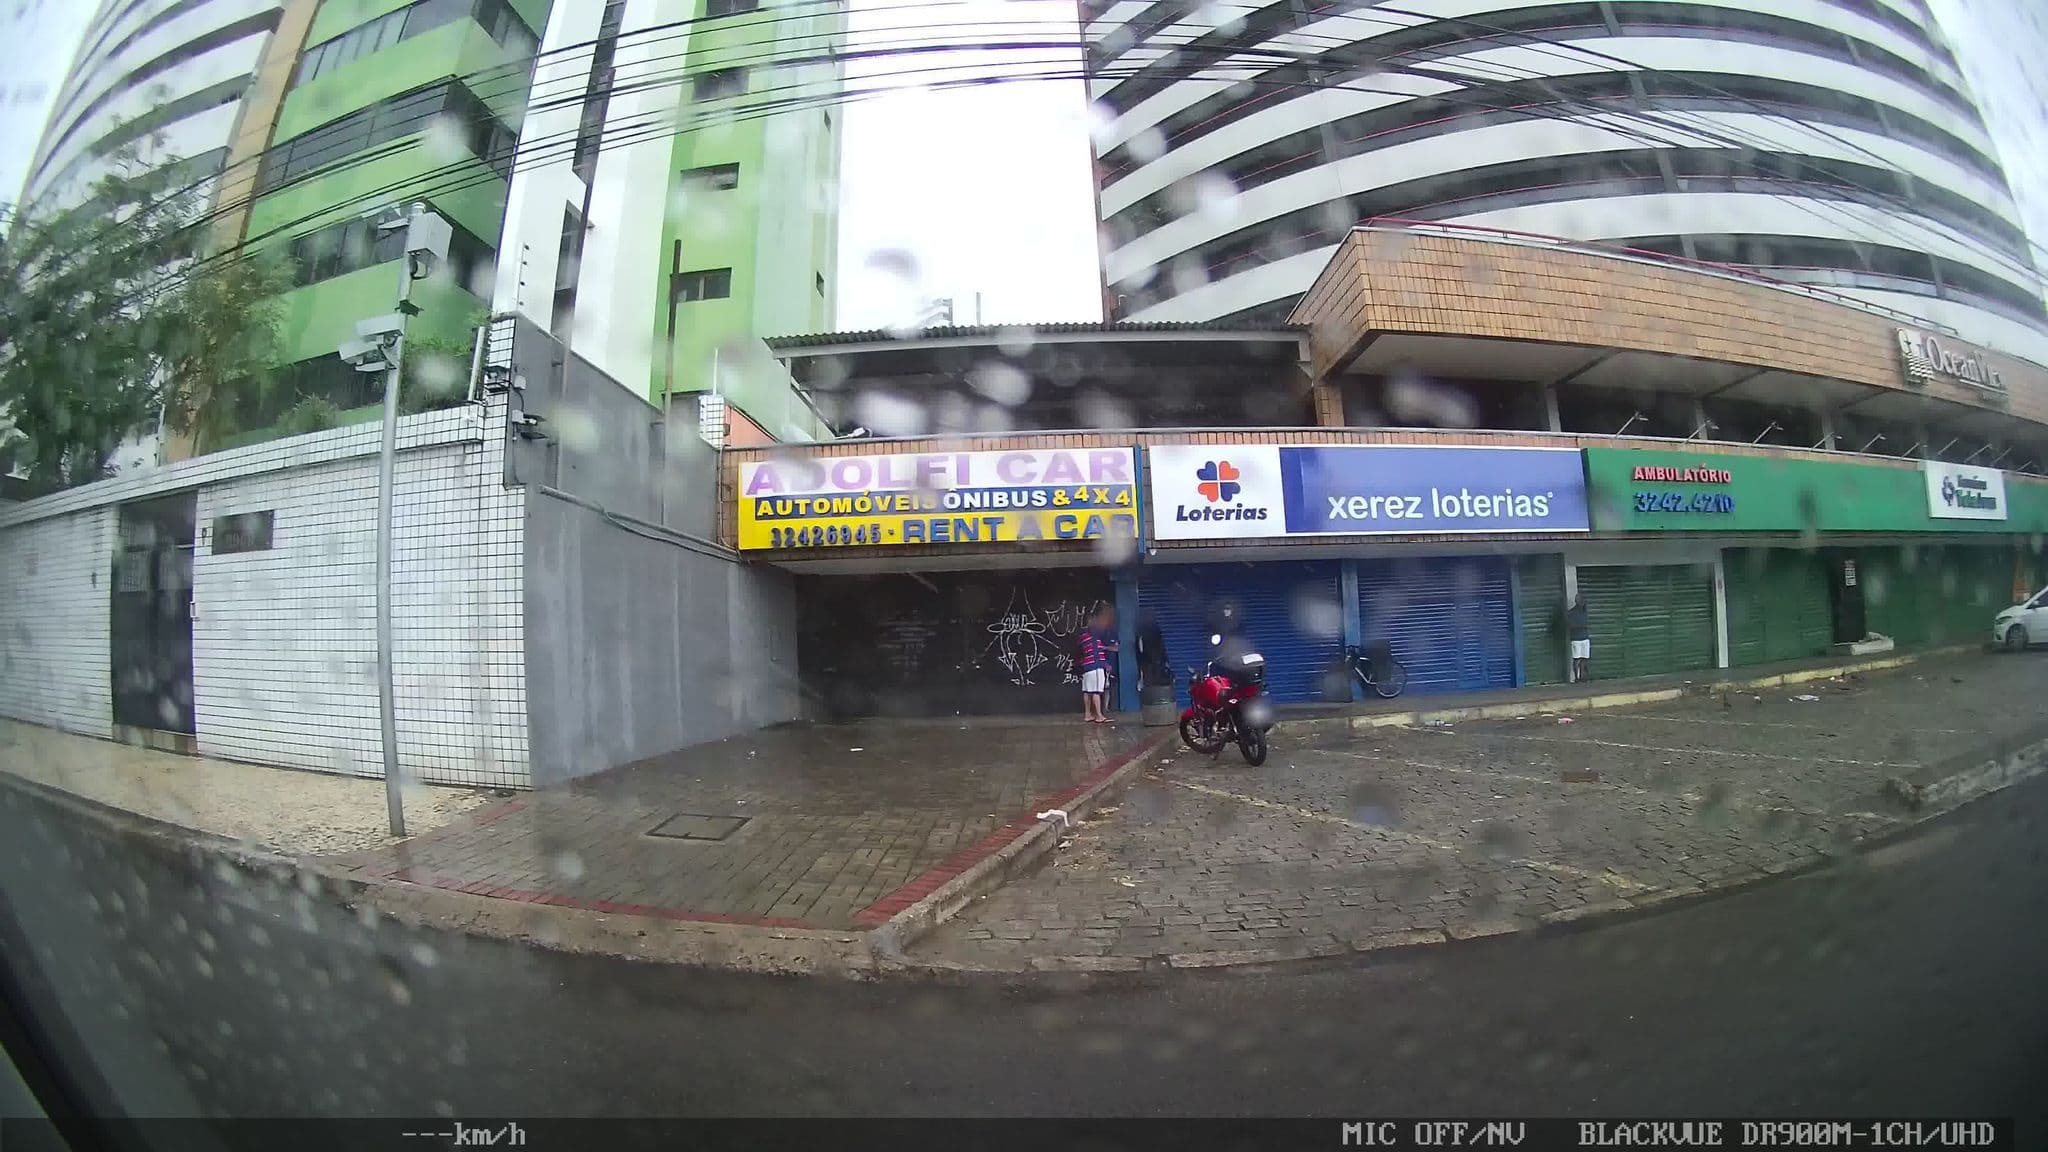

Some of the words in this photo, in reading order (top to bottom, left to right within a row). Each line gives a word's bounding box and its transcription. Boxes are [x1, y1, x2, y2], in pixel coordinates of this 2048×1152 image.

[996, 451, 1129, 484] CAR
[1633, 463, 1731, 483] AMBULATÓRIO
[757, 490, 938, 516] AUTOMÓVEIS
[943, 488, 1047, 509] ÔNIBUS
[1176, 503, 1267, 521] Loterias
[1328, 496, 1424, 519] xerez
[771, 524, 881, 548] 32426945
[903, 517, 1004, 543] RENT
[1017, 515, 1043, 539] A
